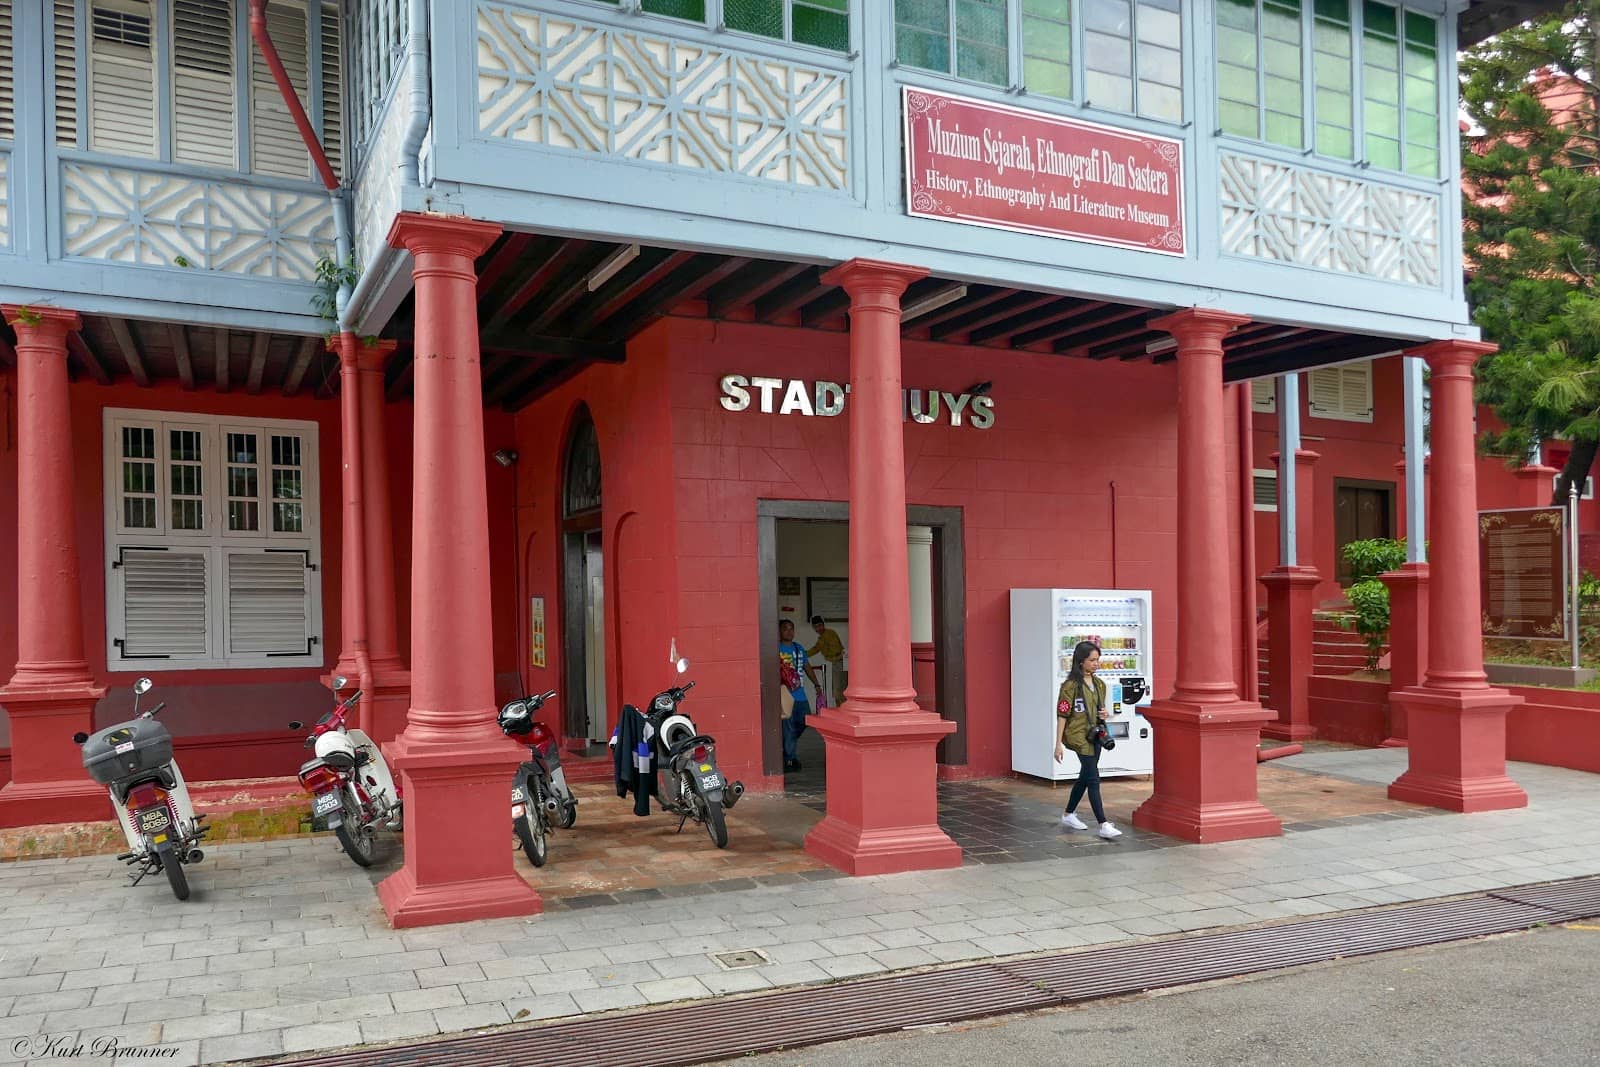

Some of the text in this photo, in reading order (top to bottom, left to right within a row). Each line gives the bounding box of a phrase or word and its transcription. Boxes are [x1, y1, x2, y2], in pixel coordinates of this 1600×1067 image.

[927, 117, 1169, 196] Muzium Sejarah, Ethnografi Dan Sastera
[926, 169, 1169, 227] History, Ethnography And Literature Museum
[720, 374, 995, 429] STADUYS
[142, 811, 164, 822] MBA
